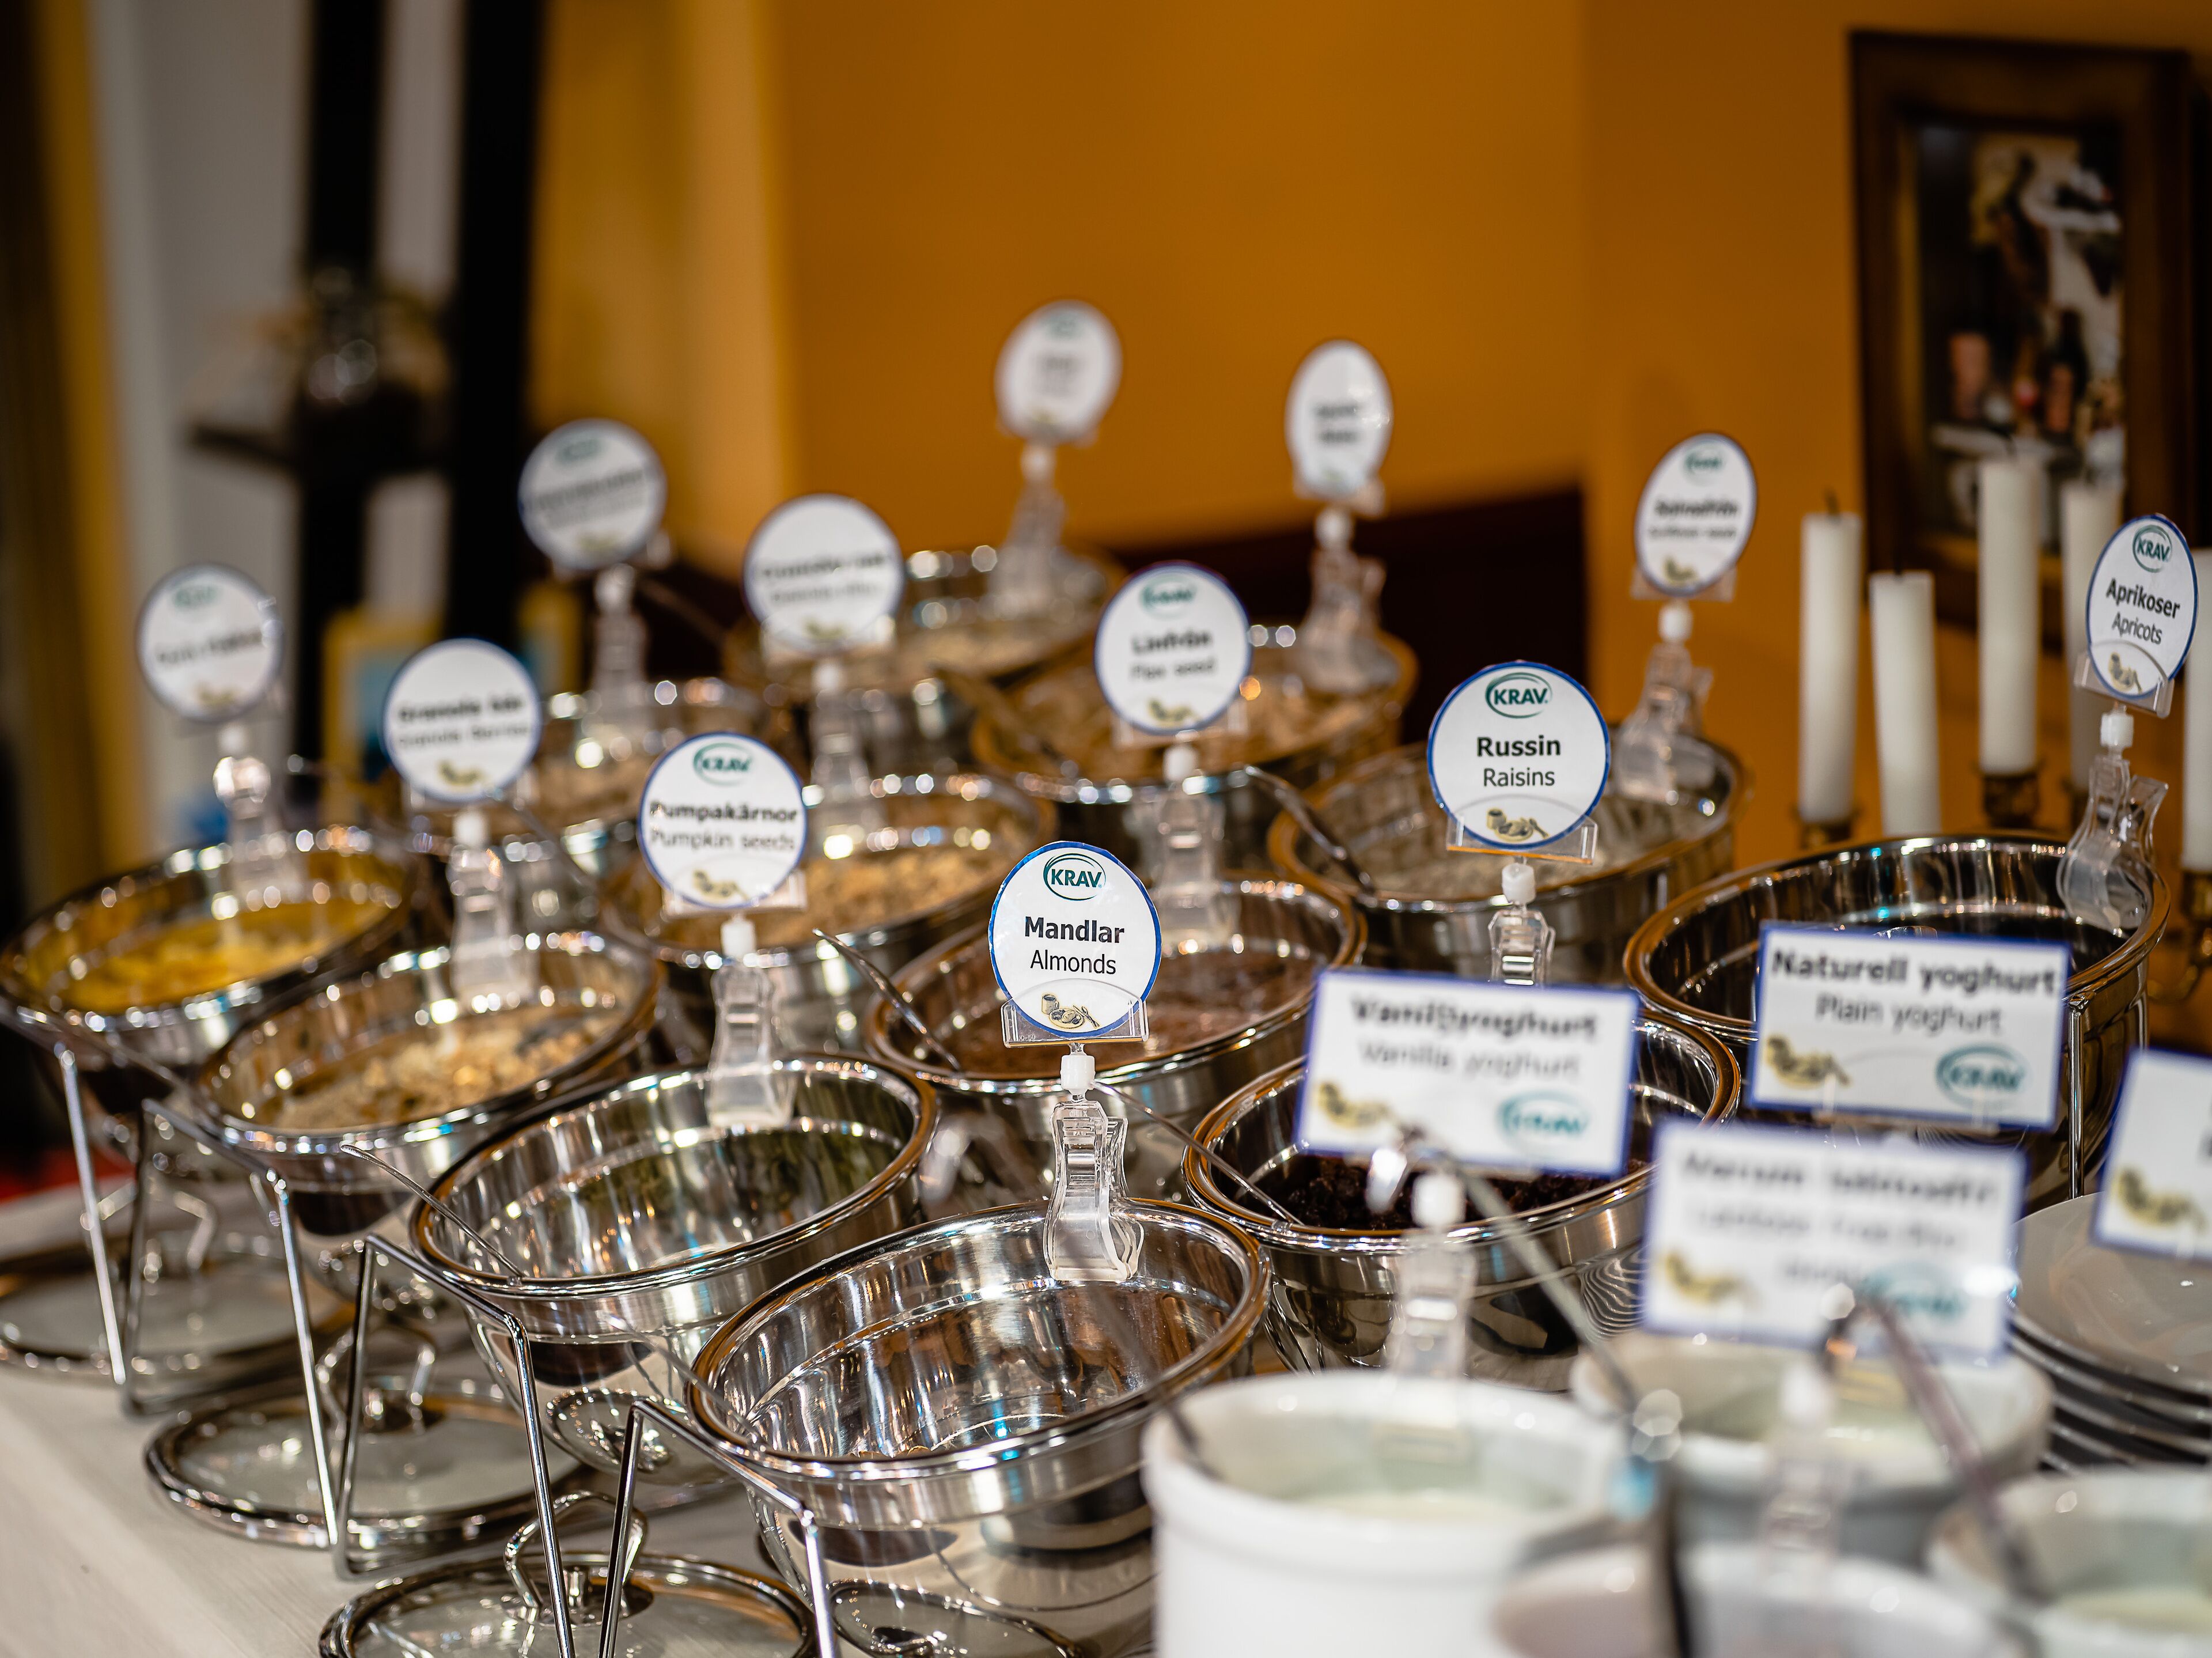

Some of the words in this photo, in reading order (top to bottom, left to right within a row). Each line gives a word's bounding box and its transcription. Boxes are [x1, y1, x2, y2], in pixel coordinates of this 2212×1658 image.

[2137, 538, 2171, 562] KRAV
[2106, 578, 2181, 619] Aprikoser
[2111, 611, 2162, 645] Apricots
[1494, 688, 1548, 705] KRAV
[1476, 735, 1561, 757] Russin
[1483, 767, 1555, 787] Raisins
[649, 801, 797, 823] Pumpakärnor
[650, 828, 732, 849] Pumpkin
[743, 834, 794, 849] seeds
[1051, 868, 1102, 888] KRAV
[1025, 916, 1125, 944] Mandlar
[1030, 949, 1116, 975] Almonds
[1771, 951, 1908, 983] Naturell
[1920, 960, 2055, 995] yoghurt
[1816, 993, 1883, 1024] Plain
[1892, 1005, 2002, 1036] yoghurt
